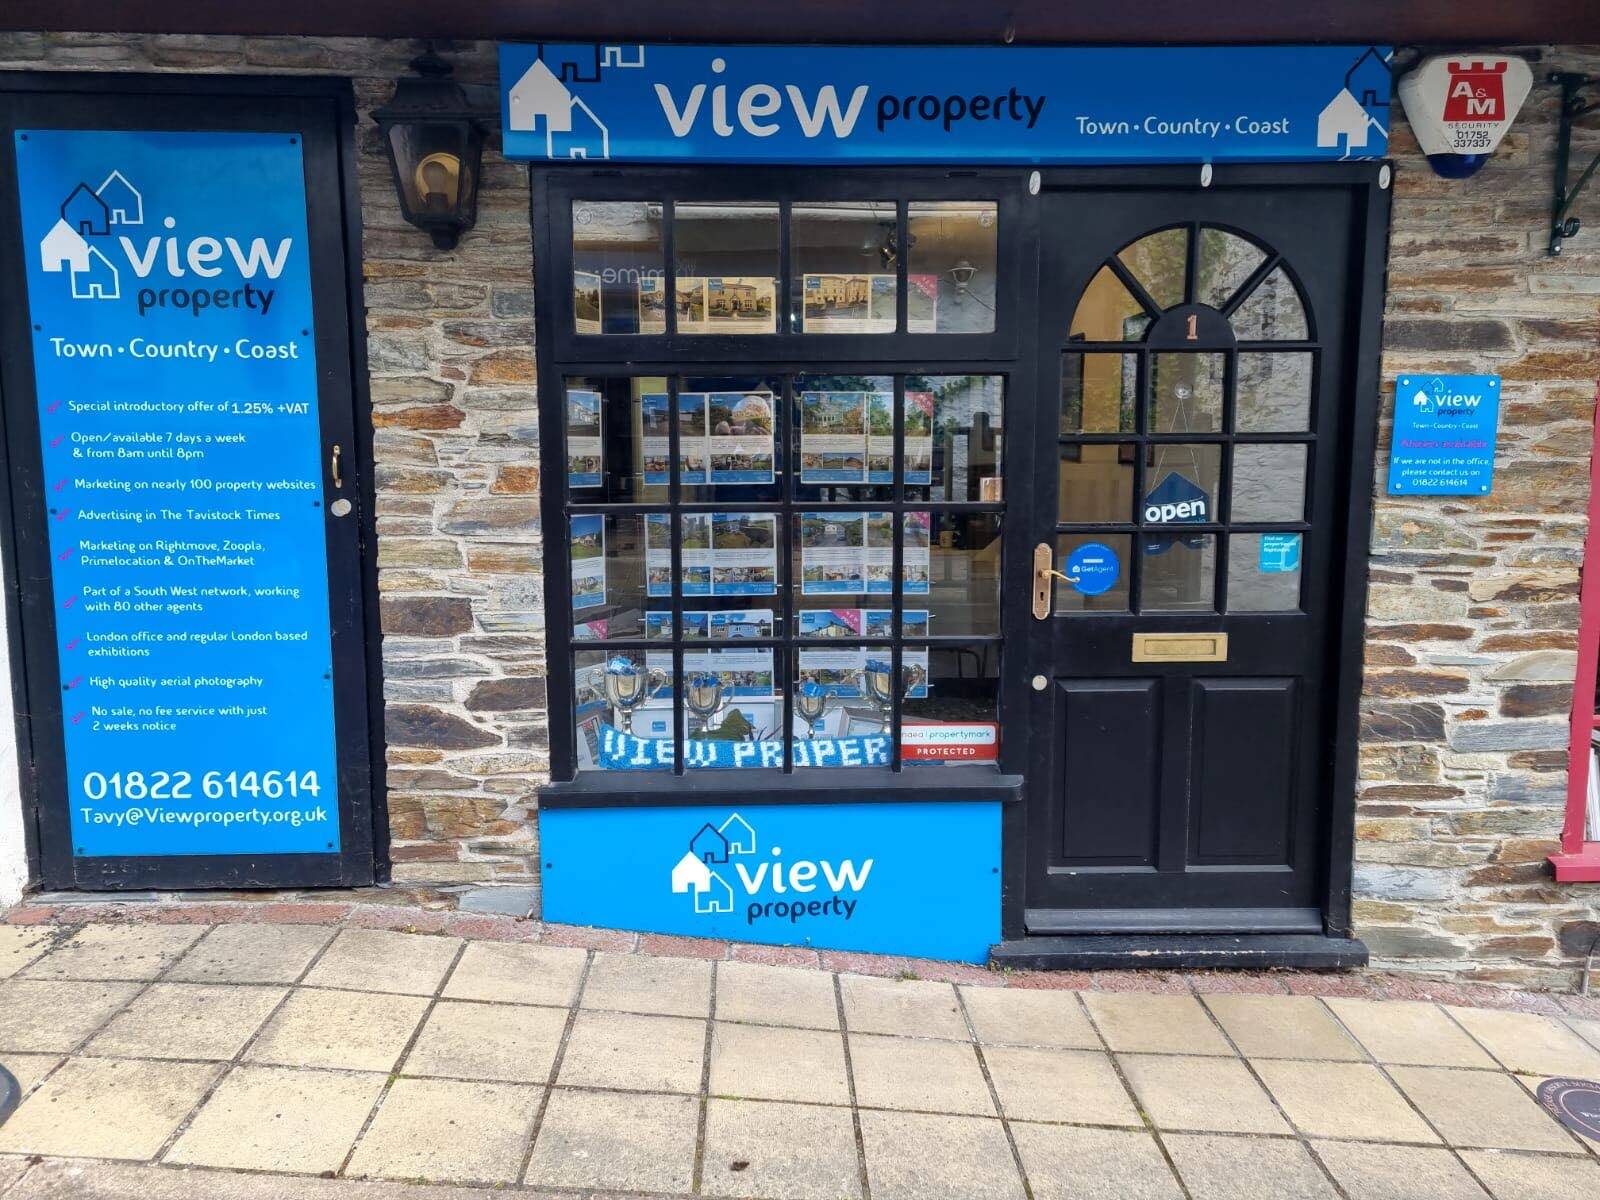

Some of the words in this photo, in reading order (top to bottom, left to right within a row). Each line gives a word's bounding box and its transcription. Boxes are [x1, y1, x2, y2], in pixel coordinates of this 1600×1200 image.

[1452, 82, 1473, 97] A
[1476, 88, 1487, 97] &
[654, 58, 868, 138] view
[877, 87, 1046, 132] property
[1467, 99, 1496, 114] M
[1076, 117, 1128, 134] Town
[1144, 117, 1220, 137] Country
[1236, 116, 1289, 133] Coast
[1457, 131, 1488, 139] 01752
[119, 214, 292, 279] view
[138, 283, 274, 316] property
[1187, 314, 1198, 340] 1
[50, 338, 112, 357] Town
[130, 338, 218, 362] Country
[236, 339, 298, 358] Coast
[1436, 390, 1481, 406] view
[69, 401, 110, 413] Special
[114, 401, 184, 413] introductory
[188, 401, 214, 411] offer
[218, 401, 228, 411] of
[232, 403, 273, 414] 1.25%
[278, 403, 308, 414] +VAT
[71, 432, 162, 444] Open/available
[176, 433, 201, 444] days
[215, 433, 245, 442] week
[73, 448, 83, 457] &
[87, 448, 114, 457] from
[118, 448, 144, 457] 8am
[147, 448, 173, 458] until
[177, 448, 204, 460] 8pm
[75, 479, 131, 492] Marketing
[152, 480, 186, 491] nearly
[190, 479, 212, 489] 100
[216, 481, 262, 491] property
[266, 480, 315, 489] websites
[78, 510, 142, 523] Advertising
[146, 510, 156, 519] in
[160, 510, 182, 519] The
[186, 510, 241, 519] Tavistock
[246, 510, 280, 519] Times
[1145, 500, 1205, 522] open
[80, 541, 135, 553] Marketing
[156, 540, 219, 553] Rightmove,
[223, 540, 264, 553] Zoopla,
[81, 556, 160, 565] Primelocation
[164, 556, 174, 565] &
[178, 556, 254, 565] OnTheMarket
[84, 586, 106, 596] Part
[110, 586, 120, 595] of
[134, 586, 167, 596] South
[171, 586, 197, 596] West
[255, 587, 299, 599] working
[85, 602, 110, 611] with
[114, 601, 130, 611] 80
[134, 602, 163, 611] other
[167, 602, 202, 614] agents
[87, 632, 128, 641] London
[131, 632, 163, 641] office
[167, 632, 187, 641] and
[190, 632, 227, 644] regular
[232, 631, 272, 640] London
[275, 631, 307, 640] based
[88, 647, 149, 656] exhibitions
[90, 677, 115, 689] High
[119, 676, 156, 688] quality
[161, 676, 191, 686] aerial
[194, 676, 262, 688] photography
[92, 706, 107, 715] No
[156, 706, 172, 715] fee
[219, 706, 243, 715] with
[246, 706, 267, 717] just
[104, 721, 138, 730] weeks
[142, 722, 176, 730] notice
[84, 772, 191, 799] 01822
[203, 771, 320, 798] 614614
[80, 806, 327, 827] Tavy@Viewproperty.org.uk
[732, 844, 873, 894] view
[747, 896, 857, 924] property
